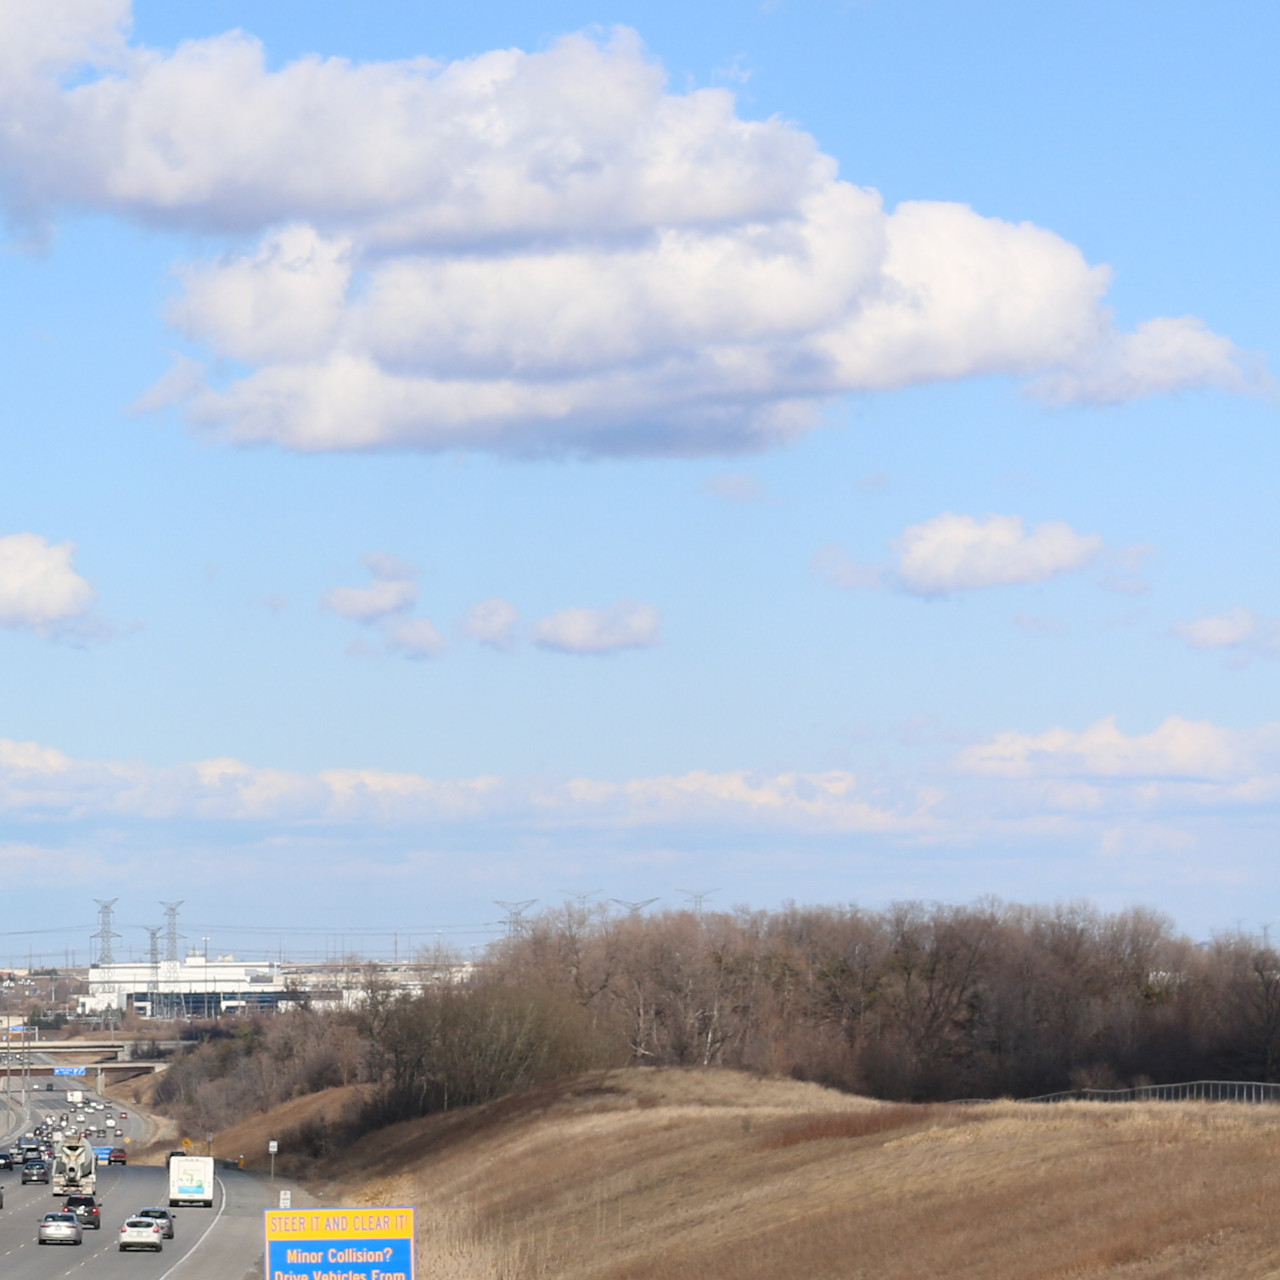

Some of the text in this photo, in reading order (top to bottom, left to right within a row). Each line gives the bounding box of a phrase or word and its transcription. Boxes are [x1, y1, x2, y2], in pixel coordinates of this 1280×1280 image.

[271, 1214, 408, 1232] STEER IT AND CLEAR IT!
[287, 1247, 393, 1263] Minor Collision?
